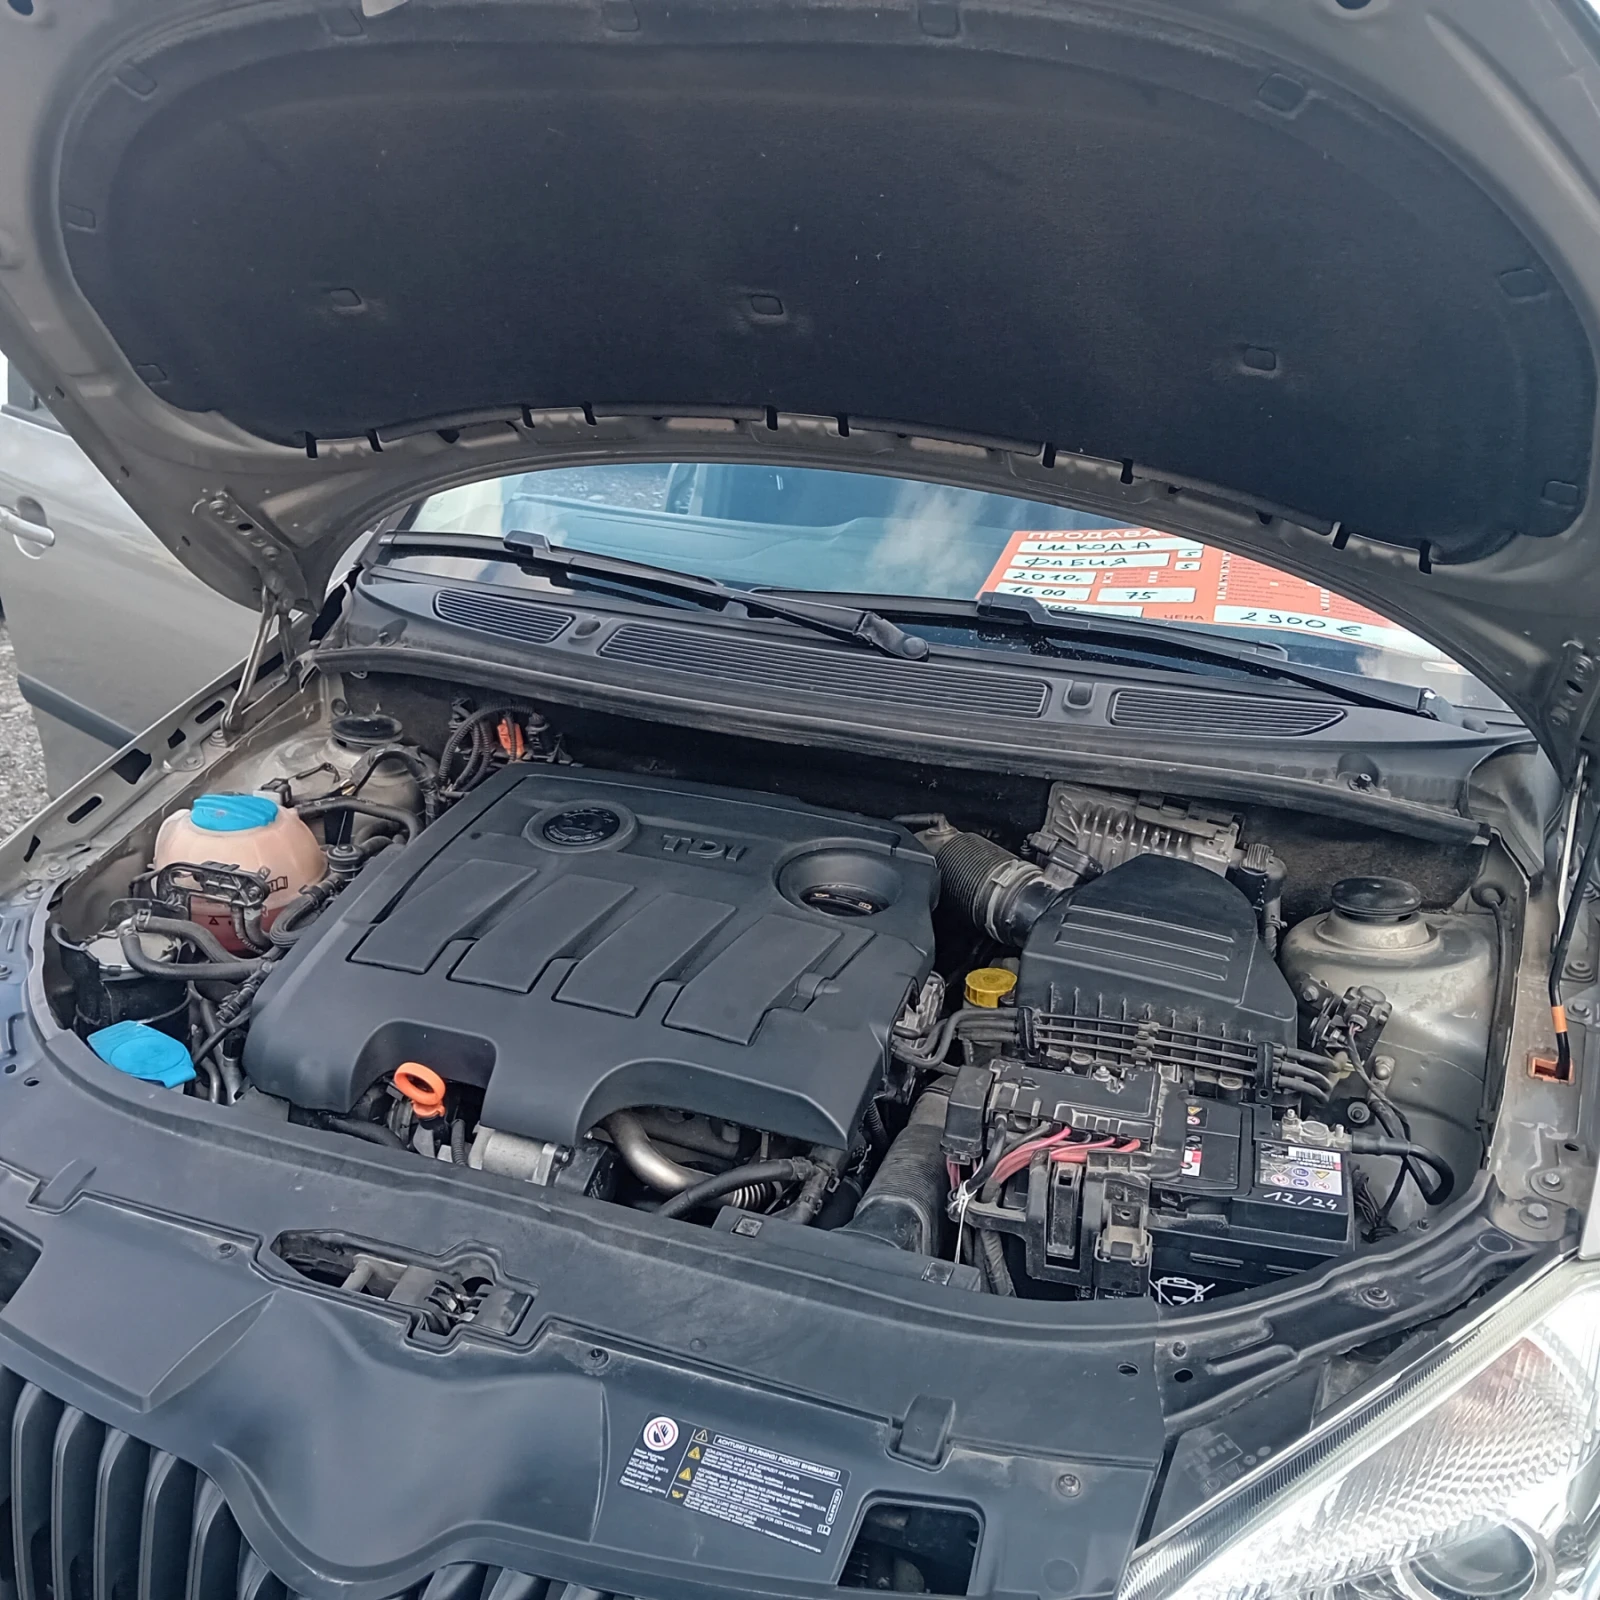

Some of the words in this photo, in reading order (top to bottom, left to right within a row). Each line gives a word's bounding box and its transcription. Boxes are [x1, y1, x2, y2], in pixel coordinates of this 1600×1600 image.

[1037, 541, 1152, 553] ШКОДА
[1125, 591, 1158, 600] 75
[662, 834, 746, 861] TDI
[1263, 1192, 1338, 1210] 12/24
[716, 1437, 747, 1451] ACHTUNG!
[747, 1446, 777, 1460] WARNING!
[777, 1455, 800, 1467] POZOR!
